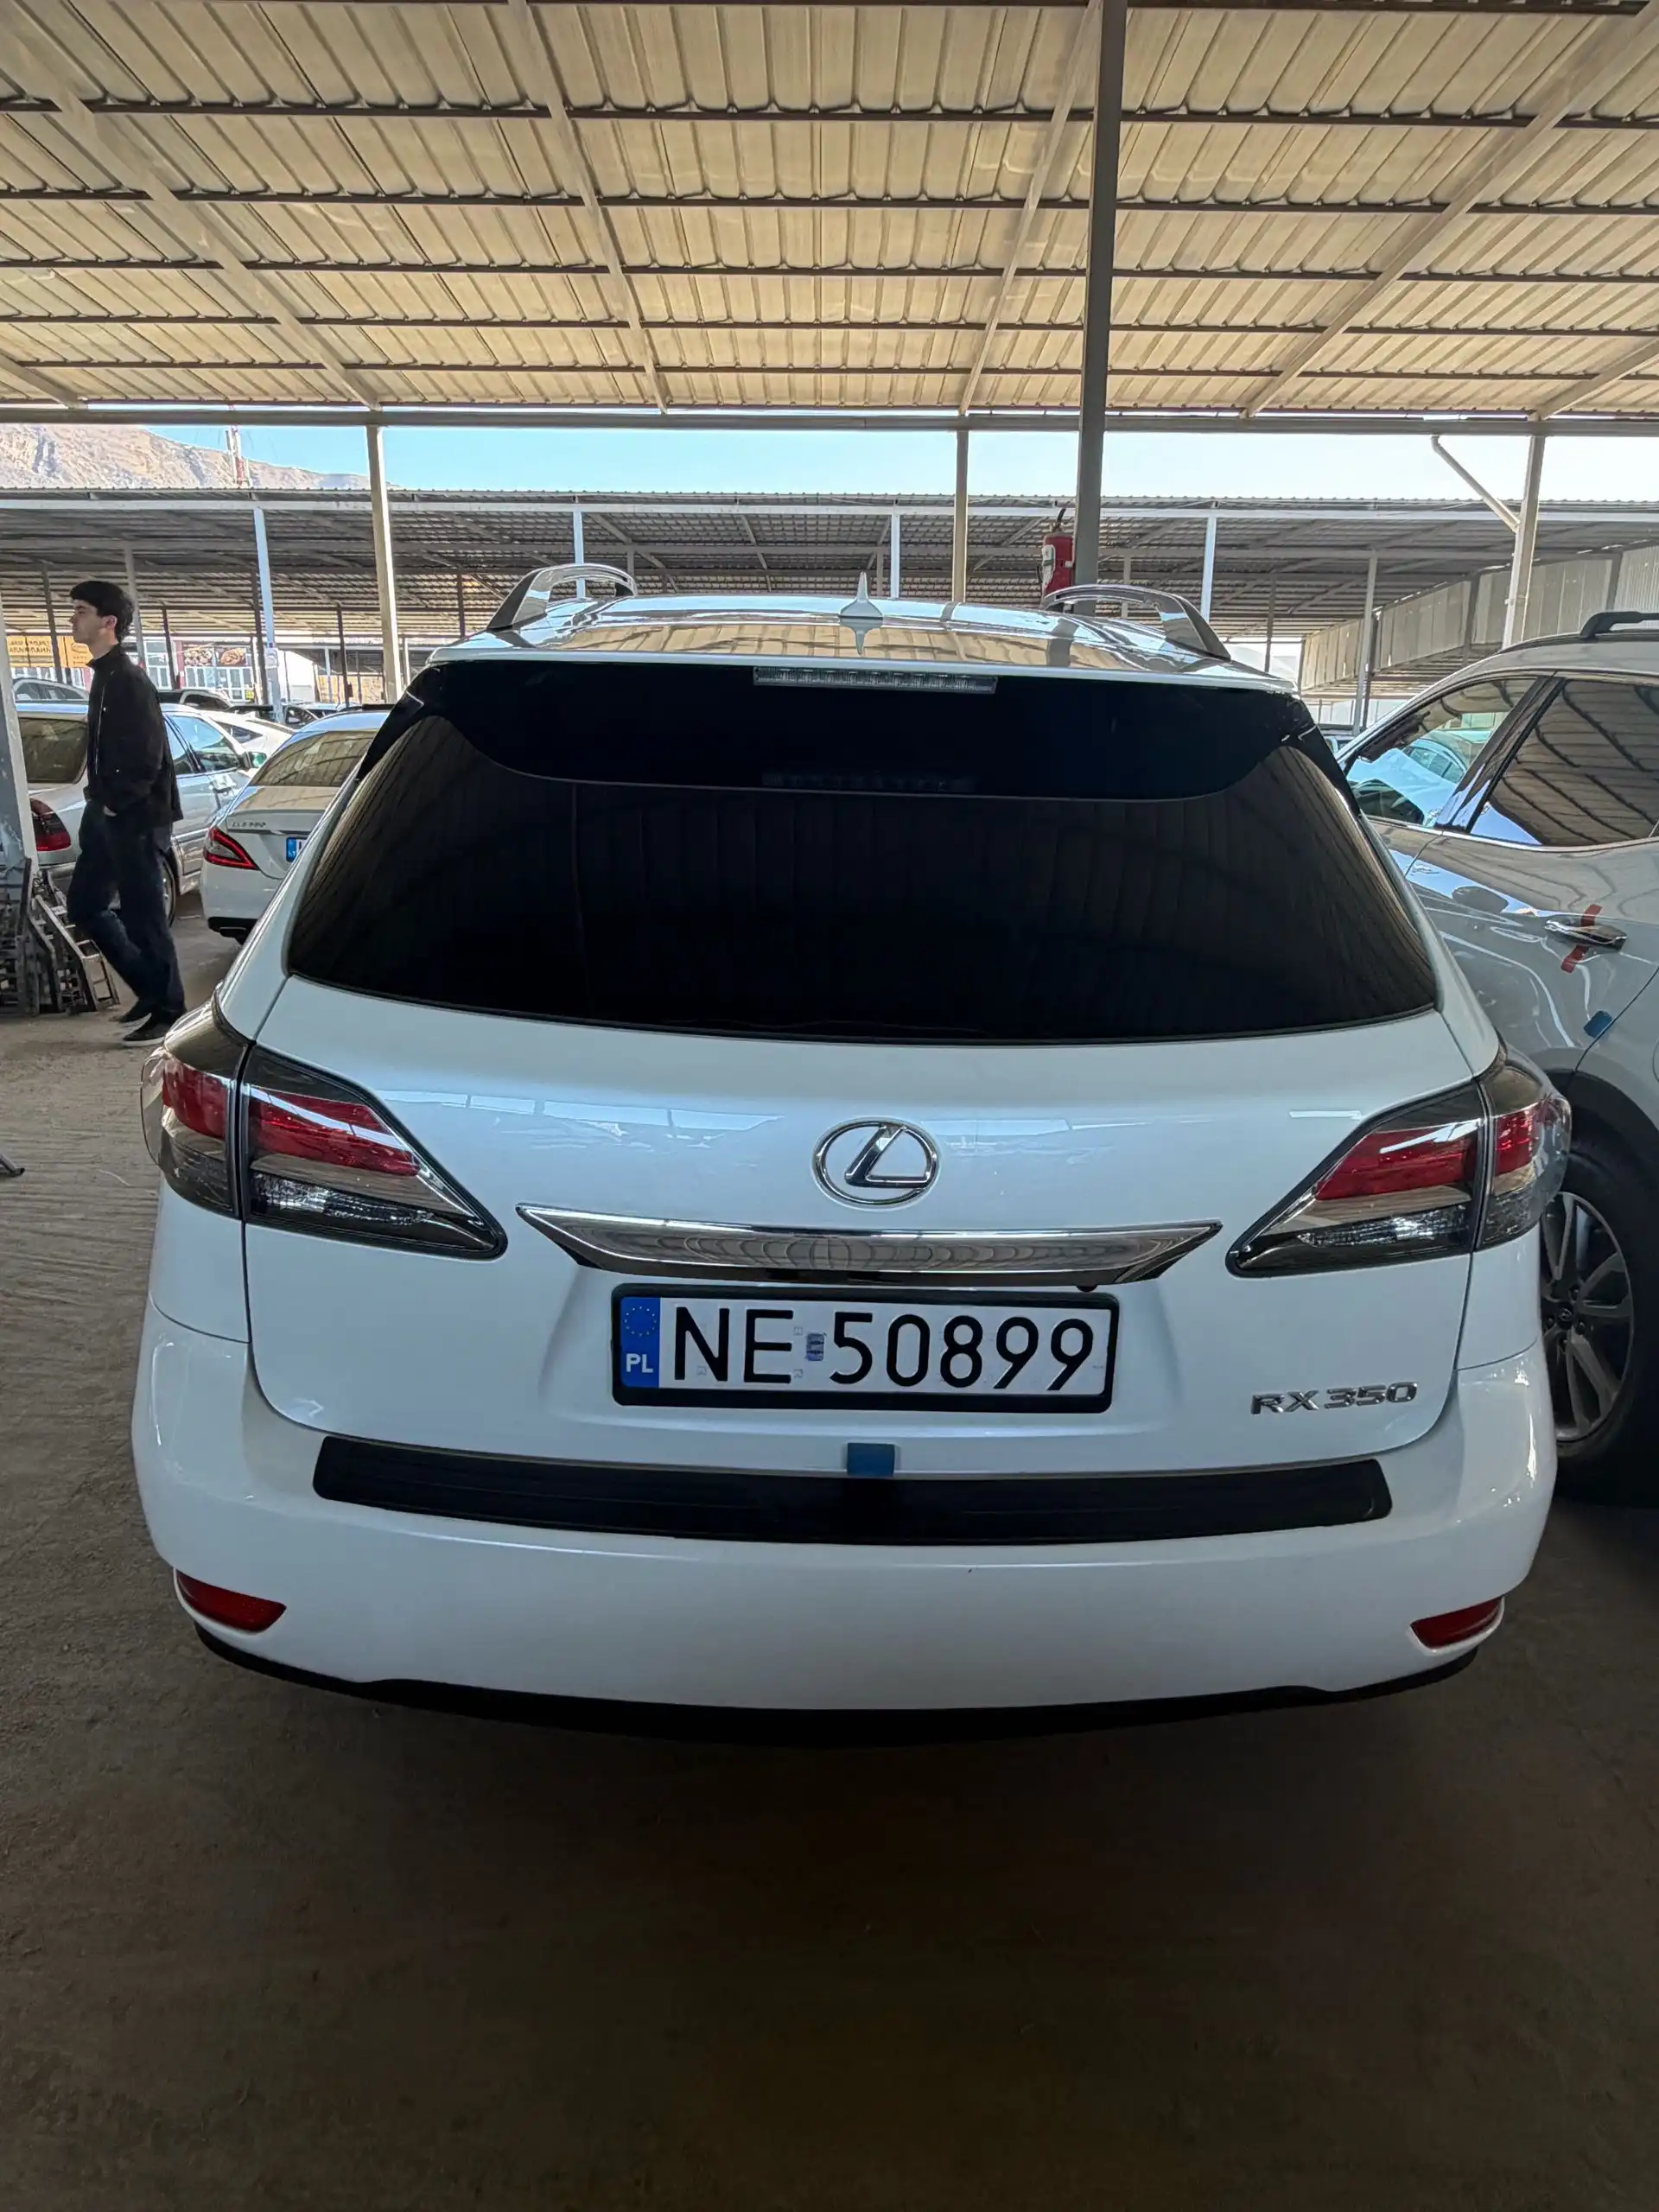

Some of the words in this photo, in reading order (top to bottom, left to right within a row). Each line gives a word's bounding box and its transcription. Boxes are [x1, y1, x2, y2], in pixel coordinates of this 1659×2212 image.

[625, 1353, 654, 1374] PL
[674, 1306, 794, 1384] NE
[829, 1312, 1094, 1391] 50899
[1250, 1389, 1319, 1414] RX
[1324, 1381, 1419, 1409] 350
